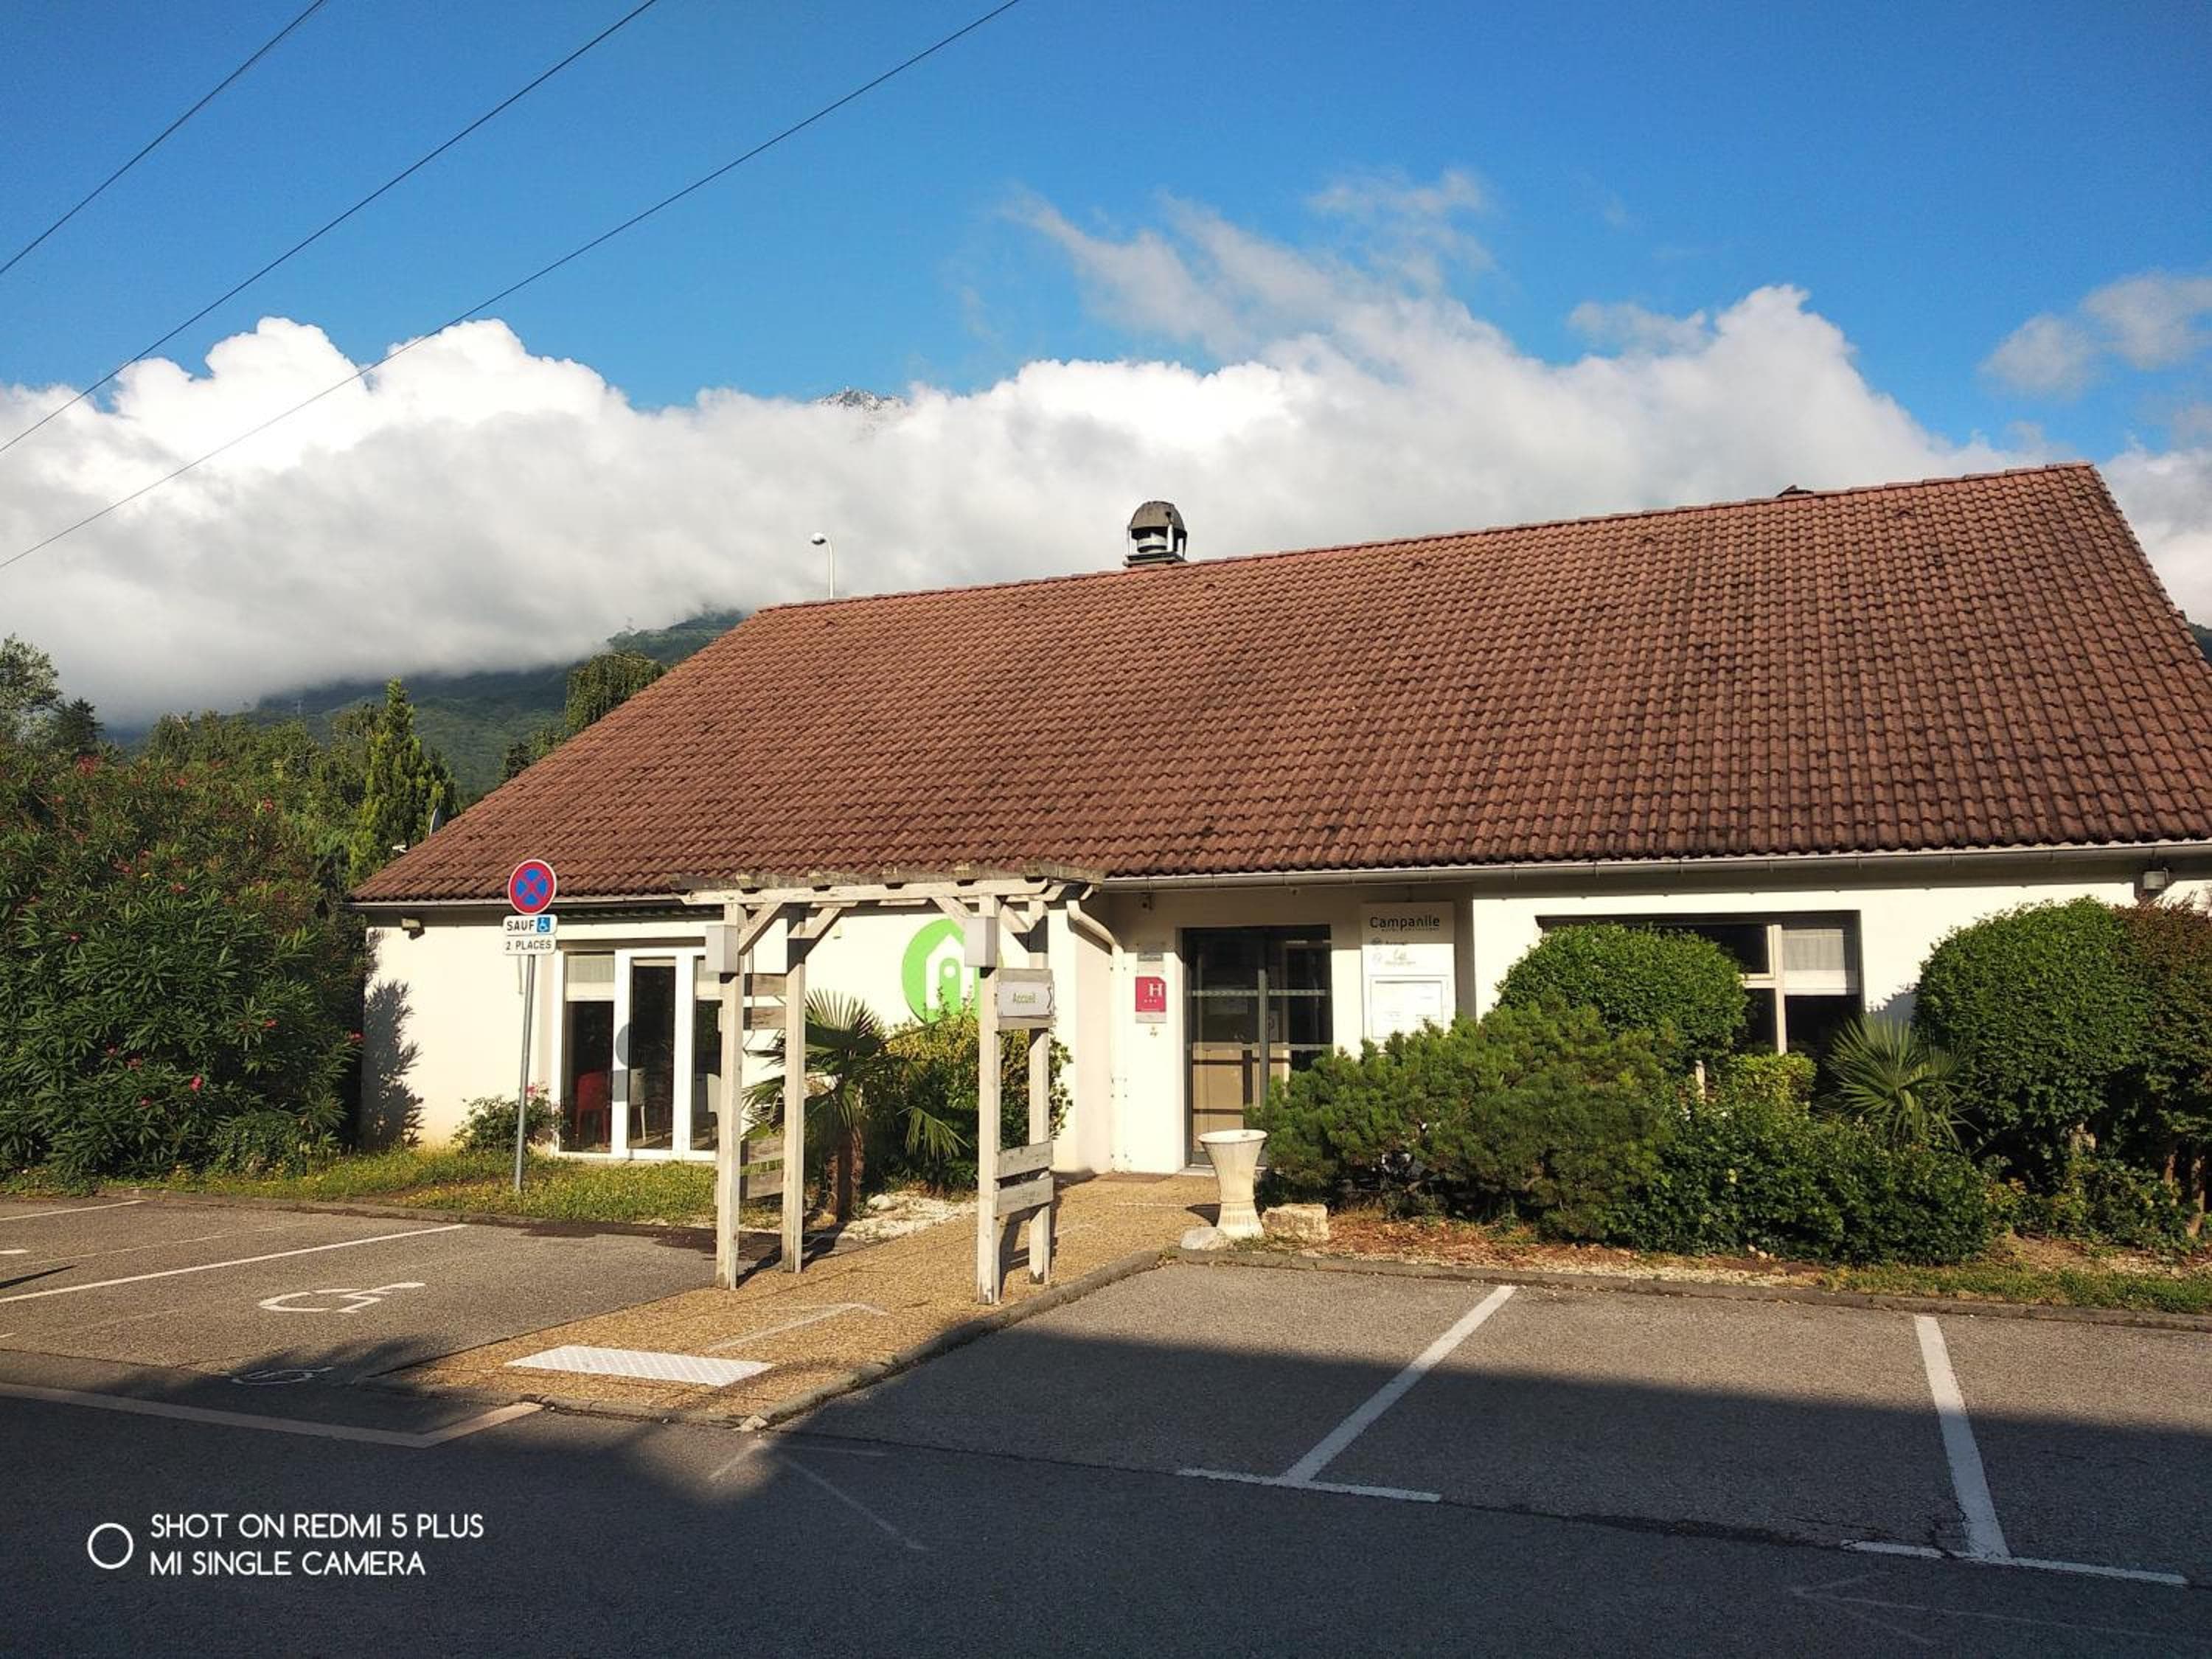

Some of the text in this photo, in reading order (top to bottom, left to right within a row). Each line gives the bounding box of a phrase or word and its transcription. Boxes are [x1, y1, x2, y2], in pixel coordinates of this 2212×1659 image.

[507, 919, 535, 931] SAUF
[1369, 914, 1440, 931] Campanile
[506, 939, 552, 950] 2 PLACES
